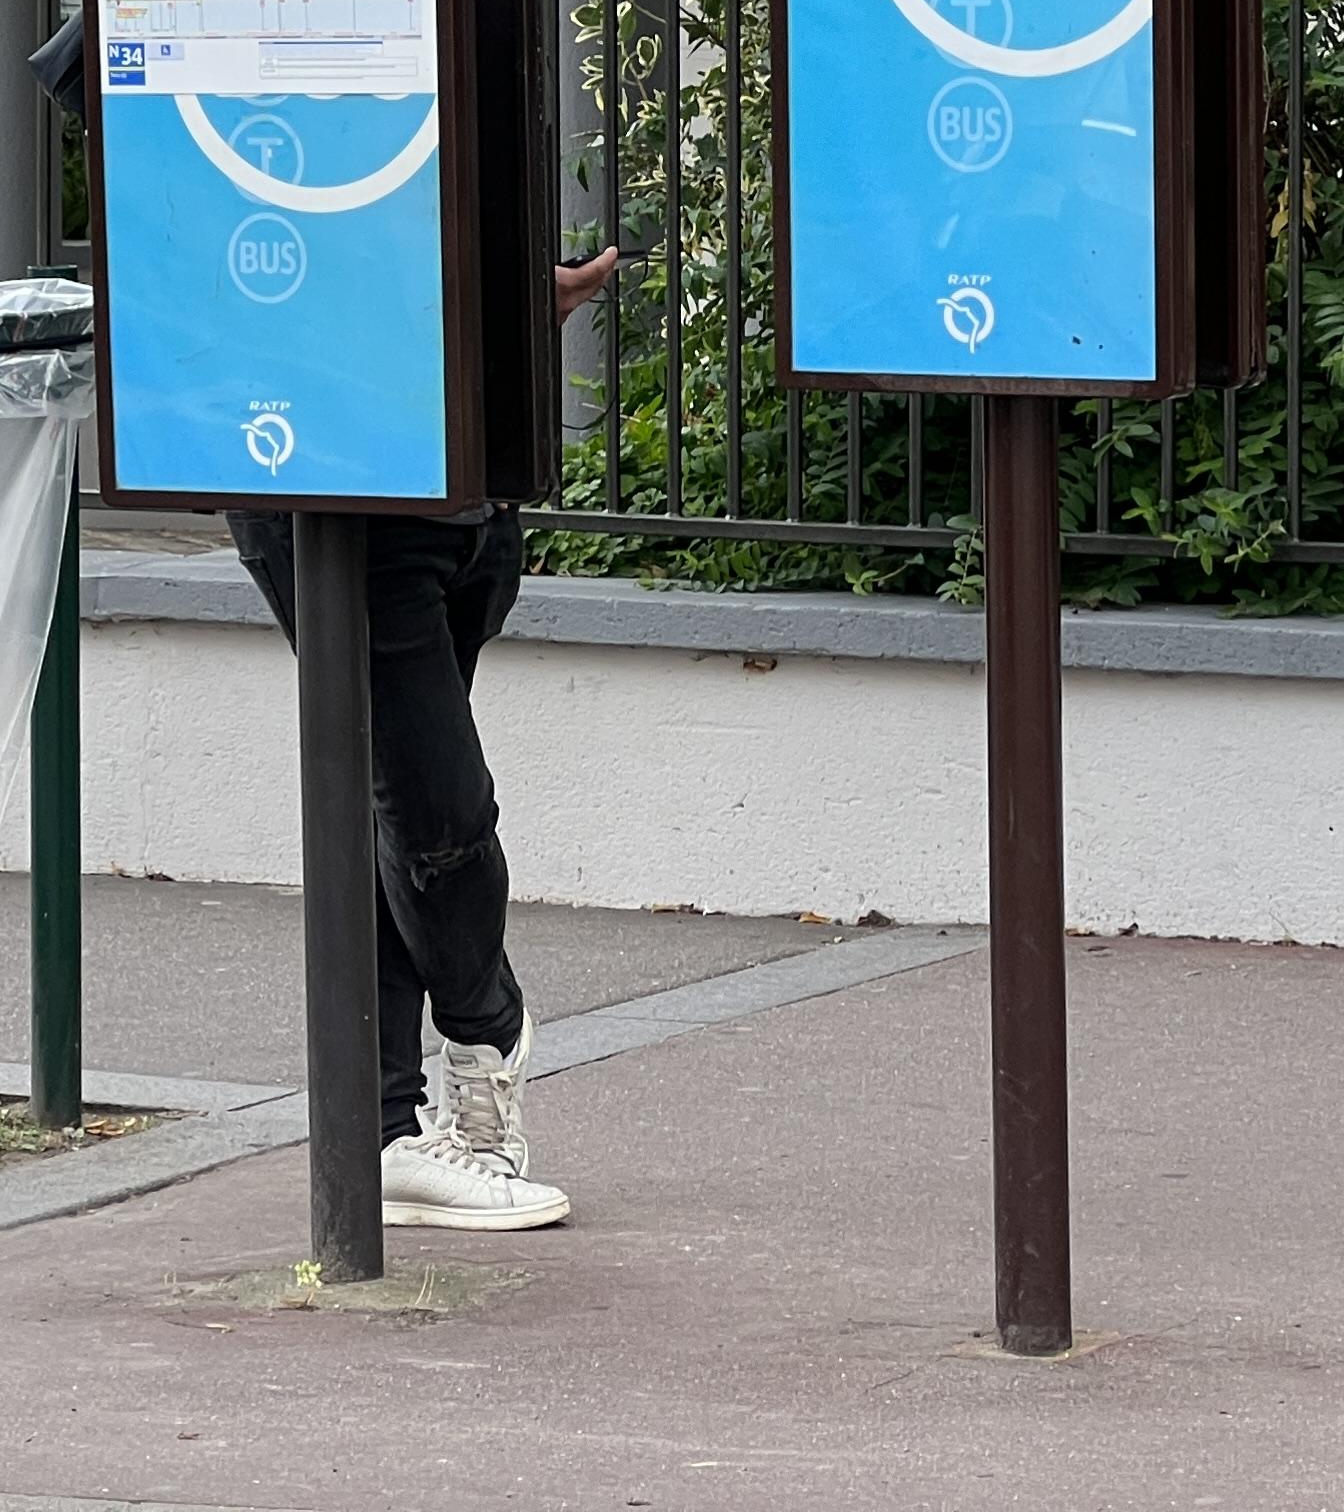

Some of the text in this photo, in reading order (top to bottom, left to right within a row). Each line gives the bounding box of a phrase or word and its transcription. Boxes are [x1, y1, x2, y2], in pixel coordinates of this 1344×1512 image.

[940, 105, 1002, 142] BUS
[247, 136, 284, 176] T
[239, 240, 296, 275] BUS
[947, 273, 992, 286] RATP
[248, 400, 291, 412] RATP
